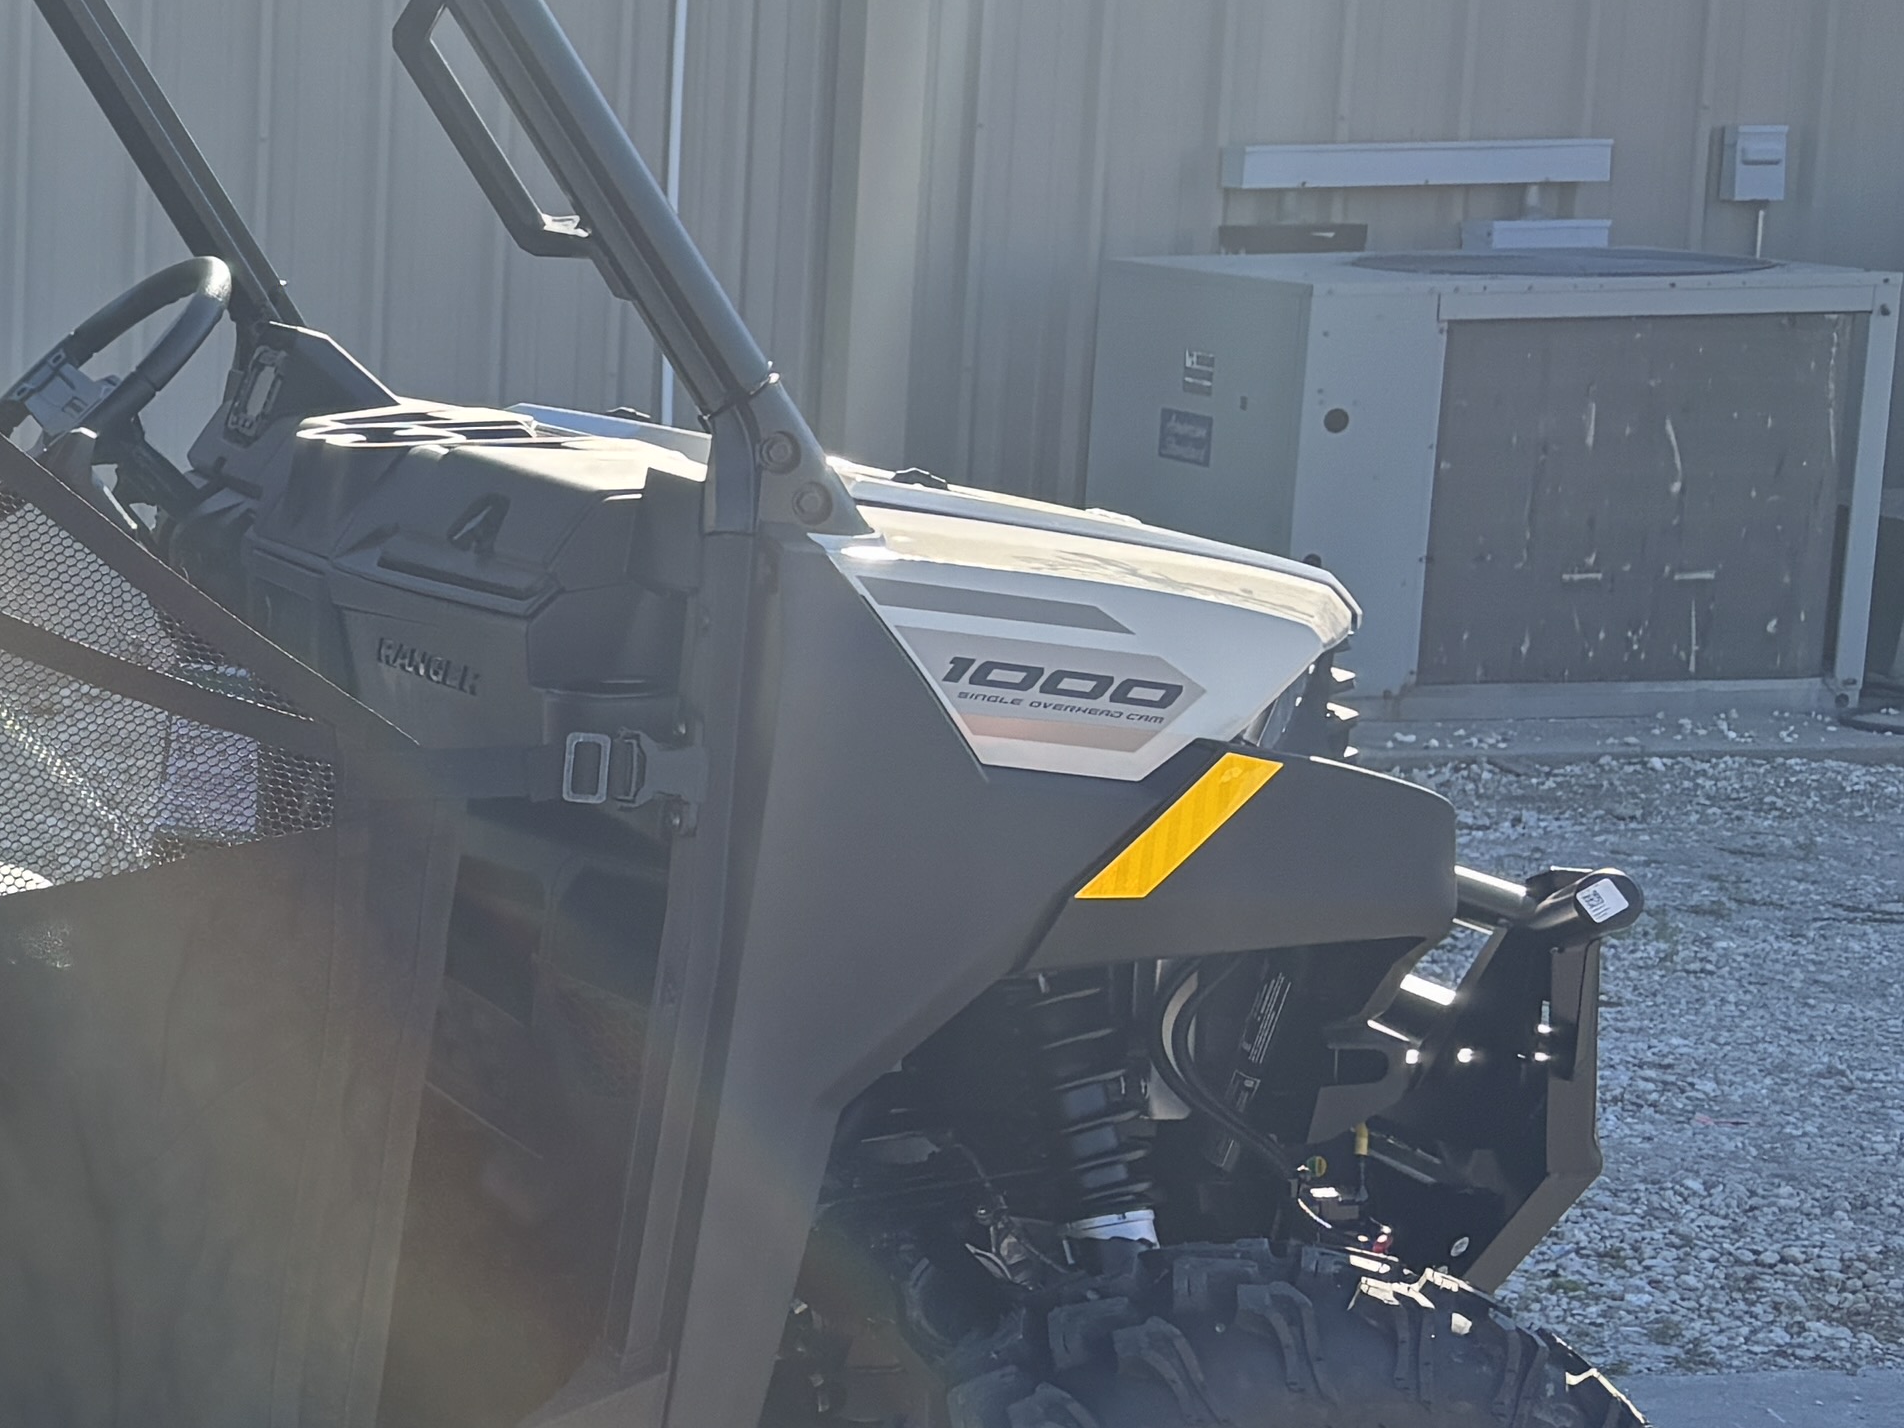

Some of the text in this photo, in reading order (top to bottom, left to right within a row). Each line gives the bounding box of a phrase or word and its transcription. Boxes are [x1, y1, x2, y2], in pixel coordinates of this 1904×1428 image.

[942, 656, 1183, 709] 1000
[957, 691, 1164, 724] SINGLE OVERHEAD CAM
